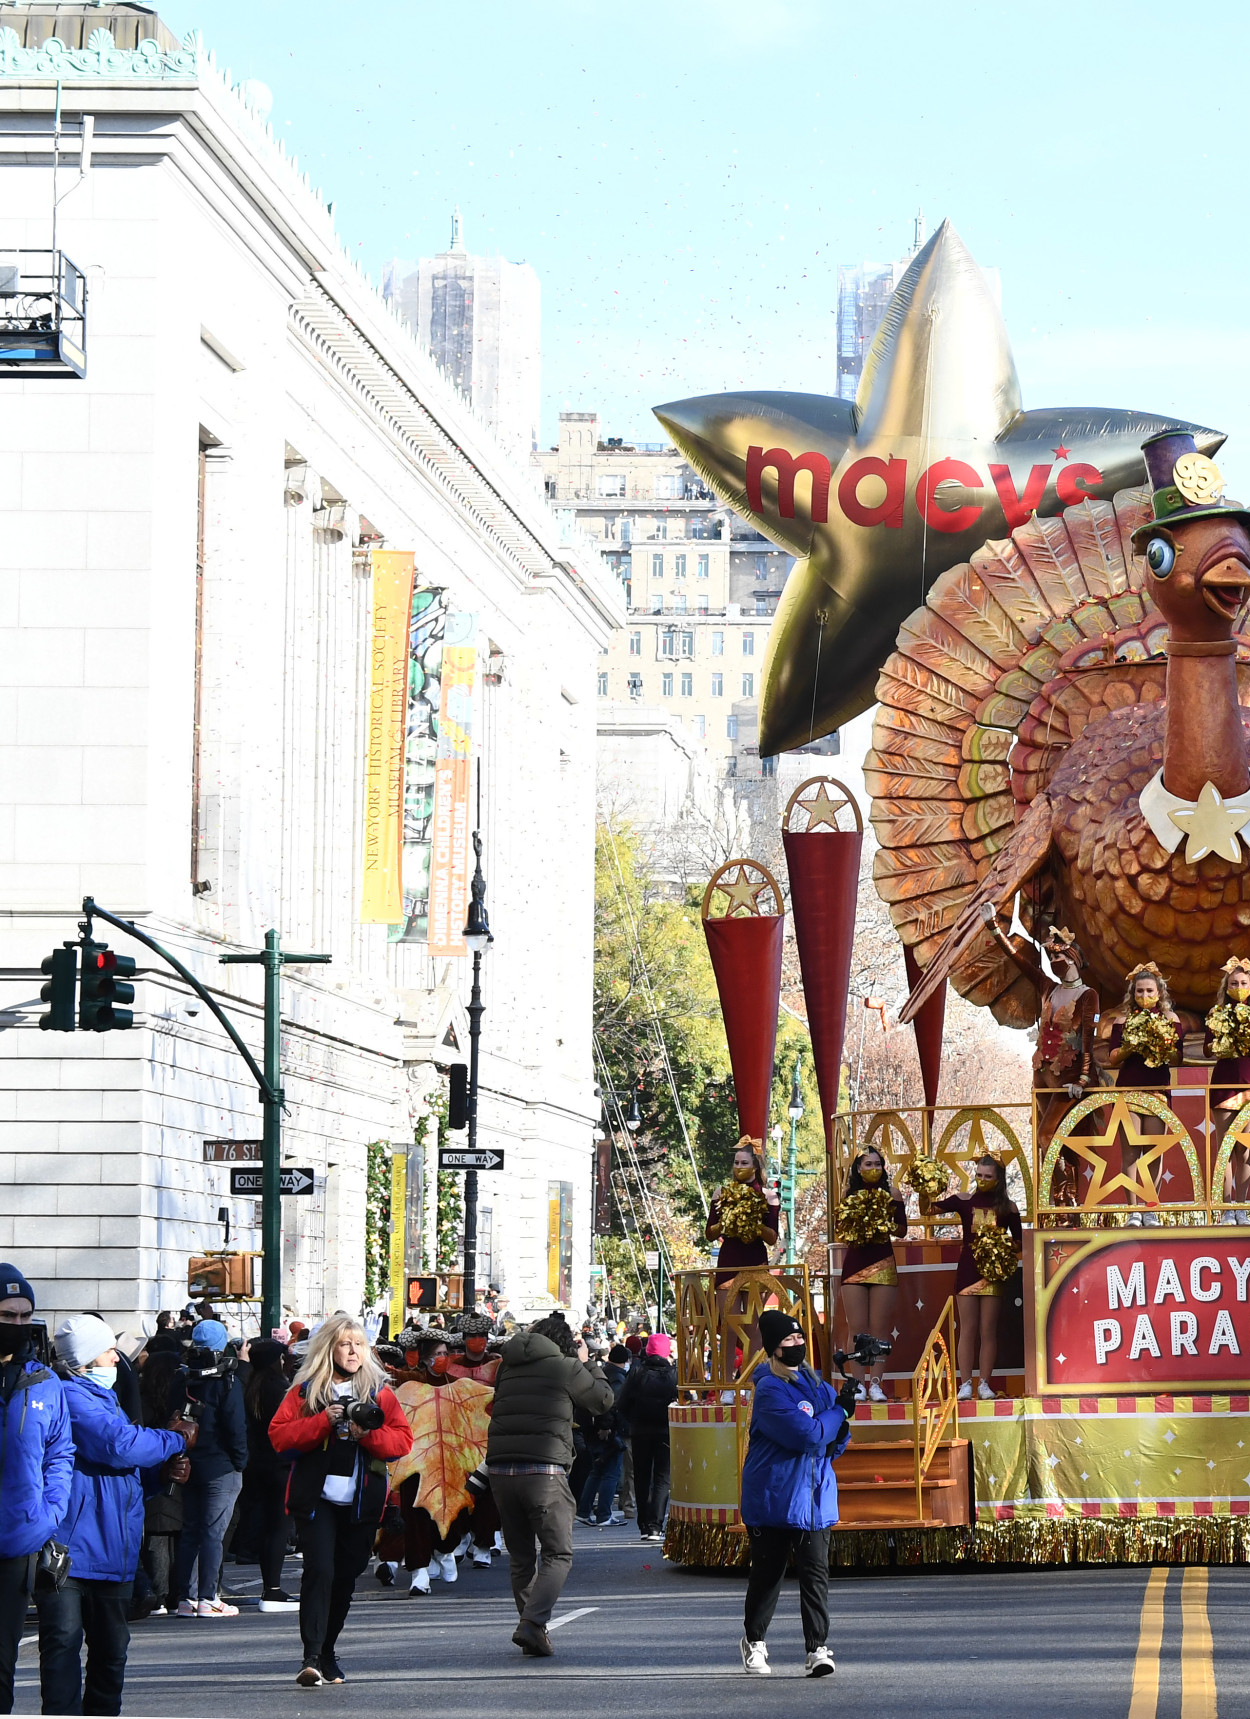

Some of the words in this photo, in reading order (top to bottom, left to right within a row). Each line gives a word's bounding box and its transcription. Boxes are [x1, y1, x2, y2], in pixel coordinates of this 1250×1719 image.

[1175, 460, 1217, 491] 95
[373, 602, 387, 671] SOCIETY
[391, 656, 405, 724] LIBRARY
[368, 678, 384, 776] HISTORICAL
[388, 747, 402, 818] MUSEUM
[437, 770, 452, 863] CHILDREN'S
[453, 802, 467, 874] MUSEUM
[434, 868, 450, 947] DIMENNA
[449, 880, 464, 947] HISTORY
[205, 1145, 215, 1160] W
[222, 1145, 236, 1160] 76
[238, 1176, 262, 1186] ONE
[448, 1155, 466, 1163] ONE
[475, 1155, 494, 1163] WAY
